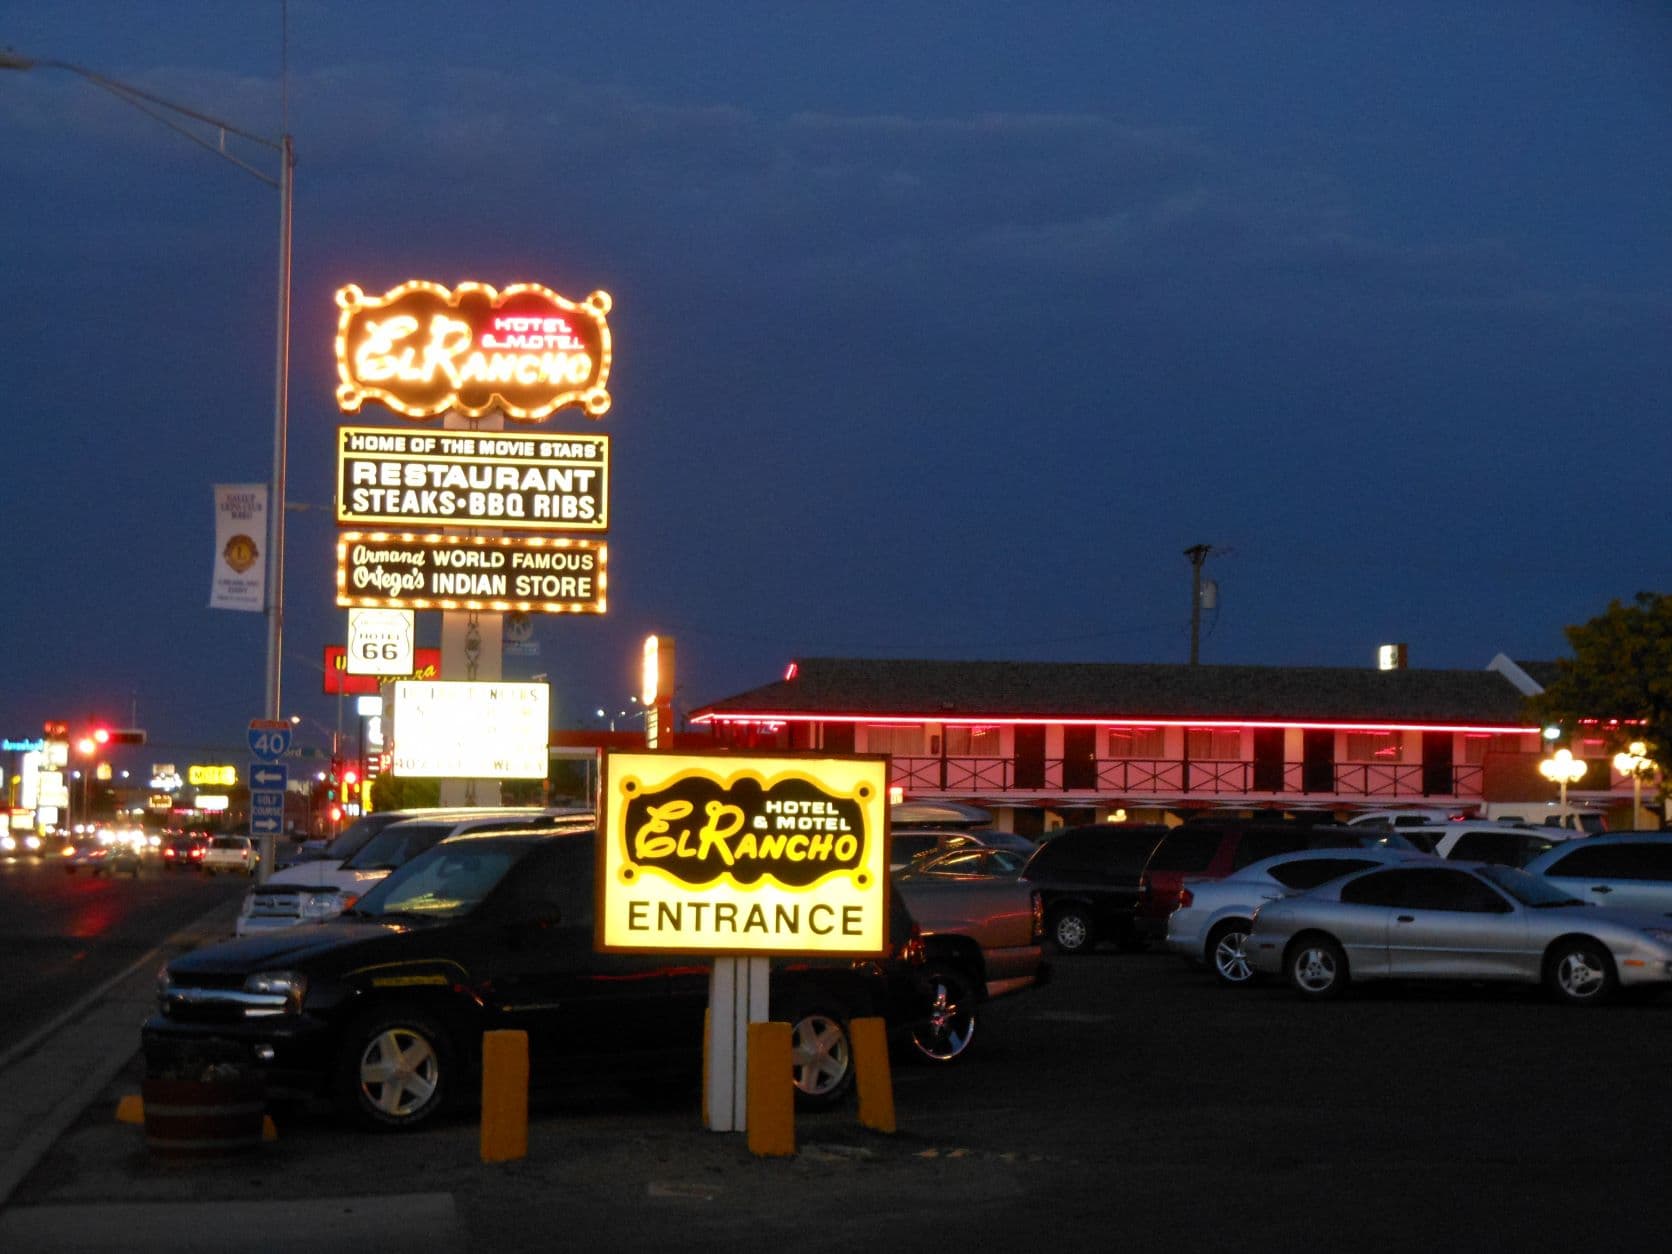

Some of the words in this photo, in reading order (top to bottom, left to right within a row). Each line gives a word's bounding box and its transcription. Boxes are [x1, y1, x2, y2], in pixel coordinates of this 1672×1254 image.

[494, 318, 571, 333] HOTEL
[504, 335, 585, 350] MOTEL
[351, 435, 405, 452] HOME
[411, 437, 435, 453] OF
[441, 438, 474, 455] THE
[479, 440, 535, 457] MOVIE
[540, 442, 596, 459] STARS
[353, 460, 596, 493] RESTAURANT
[534, 494, 595, 519] RIBS
[352, 544, 426, 566] Armand
[433, 550, 505, 568] WORLD
[512, 552, 594, 571] FAMOUS
[353, 565, 425, 597] Ortega's
[433, 572, 507, 596] INDIAN
[516, 575, 592, 598] STORE
[362, 642, 398, 661] 66
[255, 733, 285, 754] 40
[766, 800, 839, 815] HOTEL
[753, 816, 768, 829] &
[776, 816, 851, 831] MOTEL
[628, 900, 864, 936] ENTRANCE
